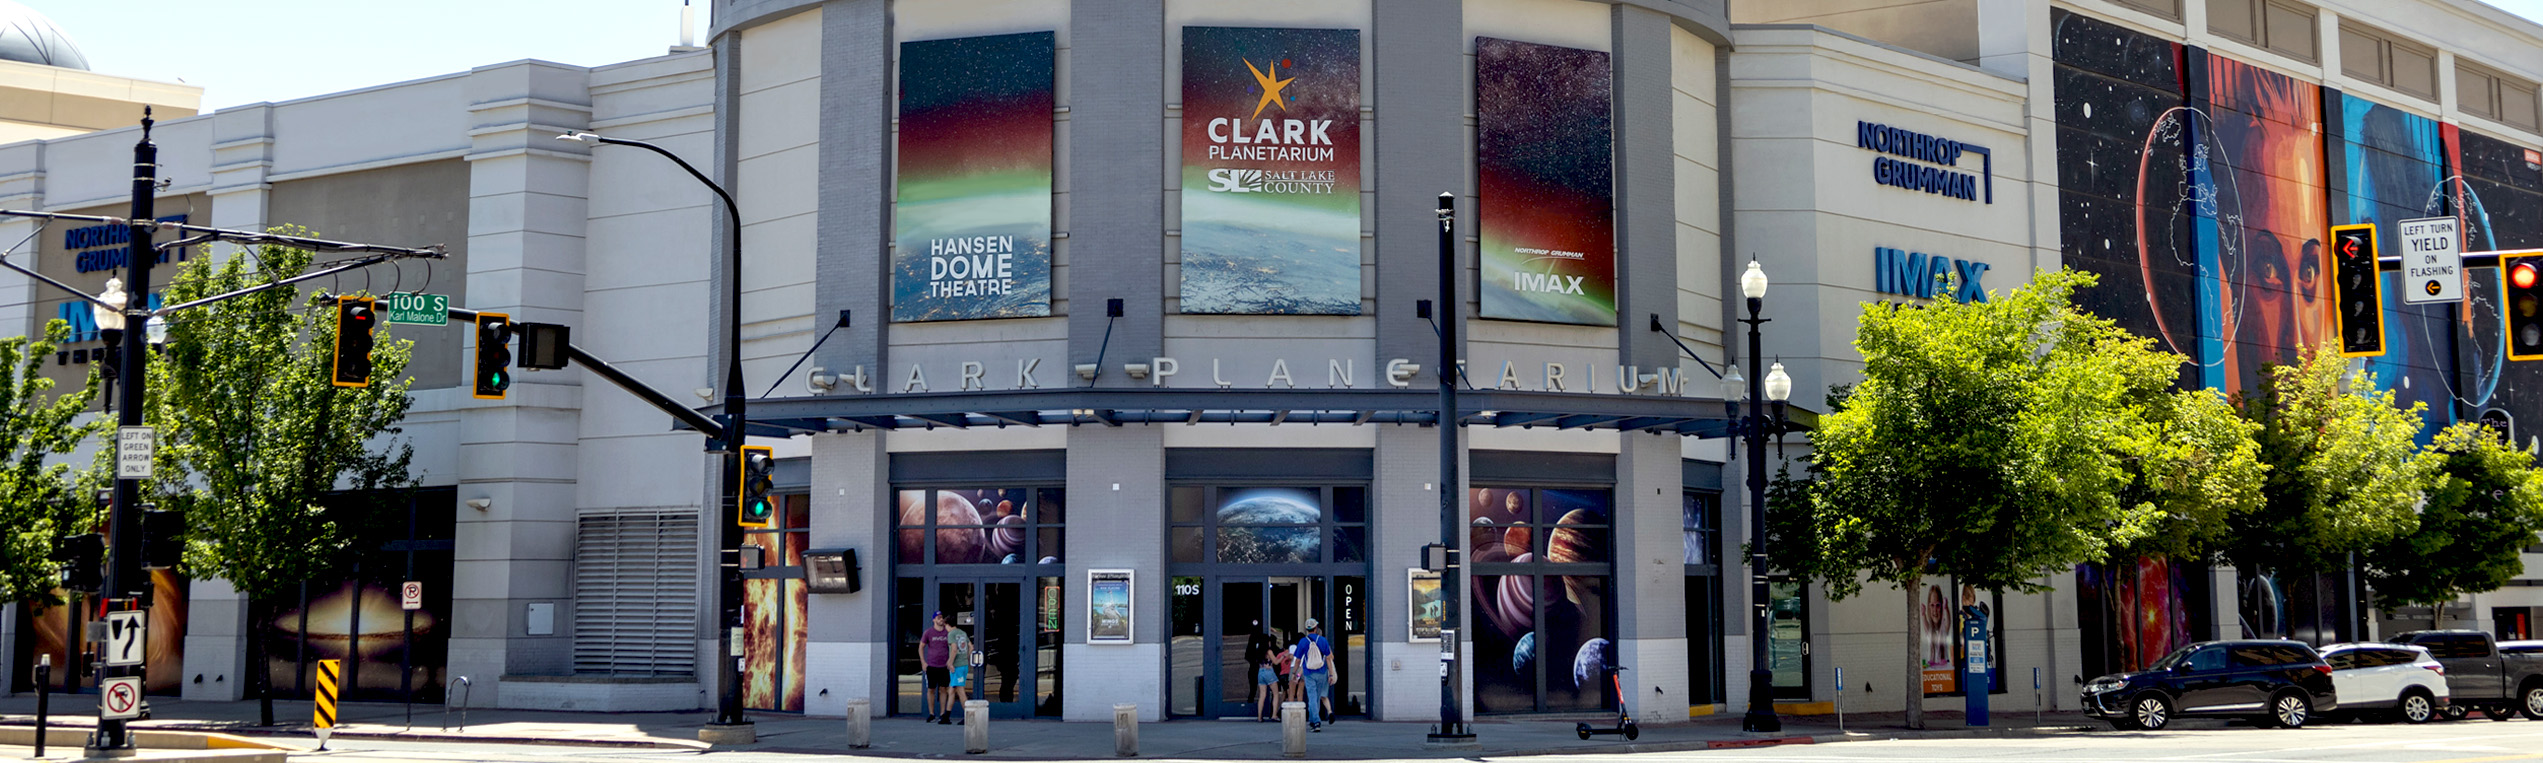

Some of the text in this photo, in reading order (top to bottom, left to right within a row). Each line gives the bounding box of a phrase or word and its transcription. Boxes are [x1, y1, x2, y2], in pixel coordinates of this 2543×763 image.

[1208, 117, 1333, 145] CLARK
[1858, 120, 1962, 167] NORTHROP
[1209, 145, 1334, 162] PLANETARIUM
[1208, 168, 1251, 193] SL
[1265, 170, 1336, 181] SALT LAKE
[1874, 156, 1977, 201] GRUMMAN
[1265, 182, 1335, 194] COUNTY
[65, 223, 131, 250] NORTHR
[2404, 223, 2453, 236] LEFT TURN
[931, 235, 1013, 256] HANSEN
[1514, 247, 1584, 258] NORTHROP GRUMMAN
[2411, 237, 2448, 252] YIELD
[931, 254, 1013, 281] DOME
[2425, 255, 2437, 264] ON
[1875, 246, 1989, 304] IMAX
[2411, 266, 2453, 277] FLASHING
[930, 279, 1012, 298] THEATRE
[1514, 271, 1585, 295] IMAX
[393, 295, 444, 312] 100 S
[390, 311, 446, 323] Karl Malone Dr
[805, 357, 1685, 395] CLARK PLANEARIUM
[121, 431, 151, 440] LEFT ON
[1048, 588, 1057, 630] OPEN
[1971, 627, 1979, 637] P
[1931, 683, 1943, 691] TOYS
